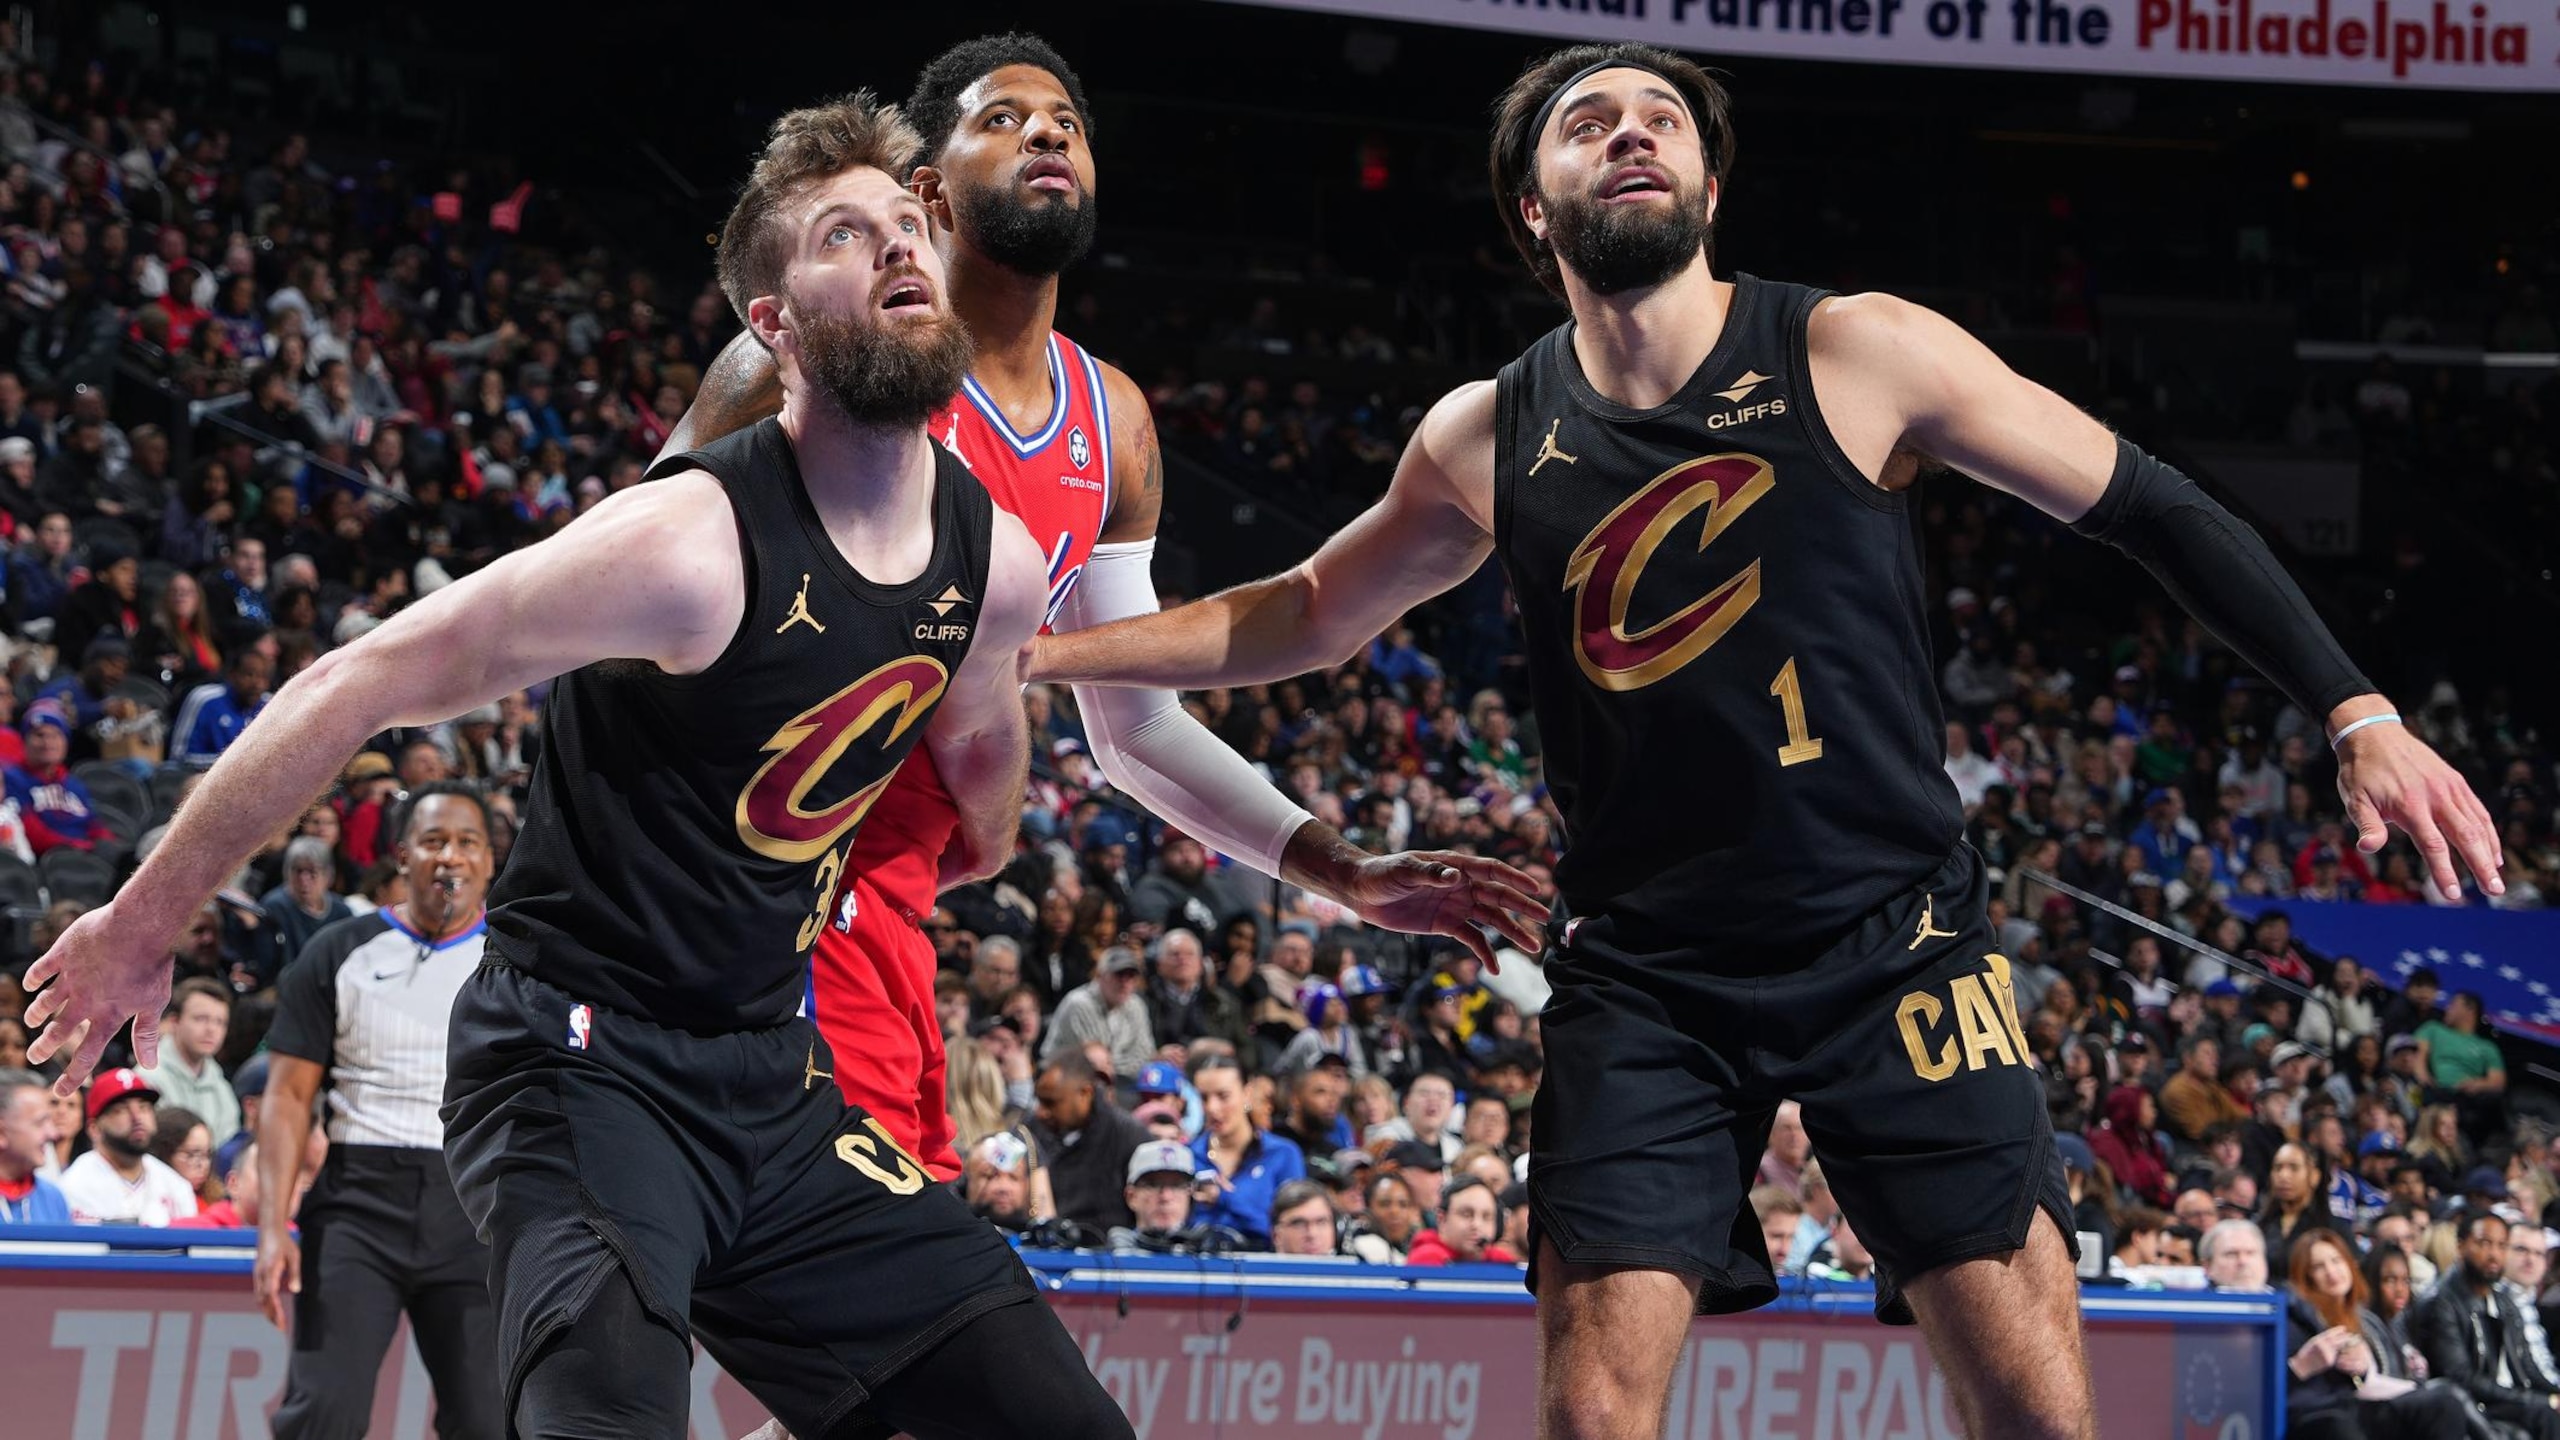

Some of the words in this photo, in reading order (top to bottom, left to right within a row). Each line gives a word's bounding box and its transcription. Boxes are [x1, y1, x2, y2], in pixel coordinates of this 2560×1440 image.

[1926, 0, 1985, 40] of
[2011, 0, 2111, 46] the
[2136, 0, 2528, 78] Philadelphia
[1708, 399, 1787, 430] CLIFFS
[1563, 452, 1777, 692] C
[914, 623, 969, 642] CLIFFS
[736, 654, 949, 863] C
[1770, 656, 1823, 767] 1
[796, 838, 853, 952] 3
[1895, 954, 2035, 1082] CAV
[50, 1310, 290, 1440] TIR
[1181, 1333, 1285, 1424] Tire
[1295, 1335, 1482, 1440] Buying
[1658, 1337, 1806, 1440] IRE
[1812, 1341, 1964, 1440] RA
